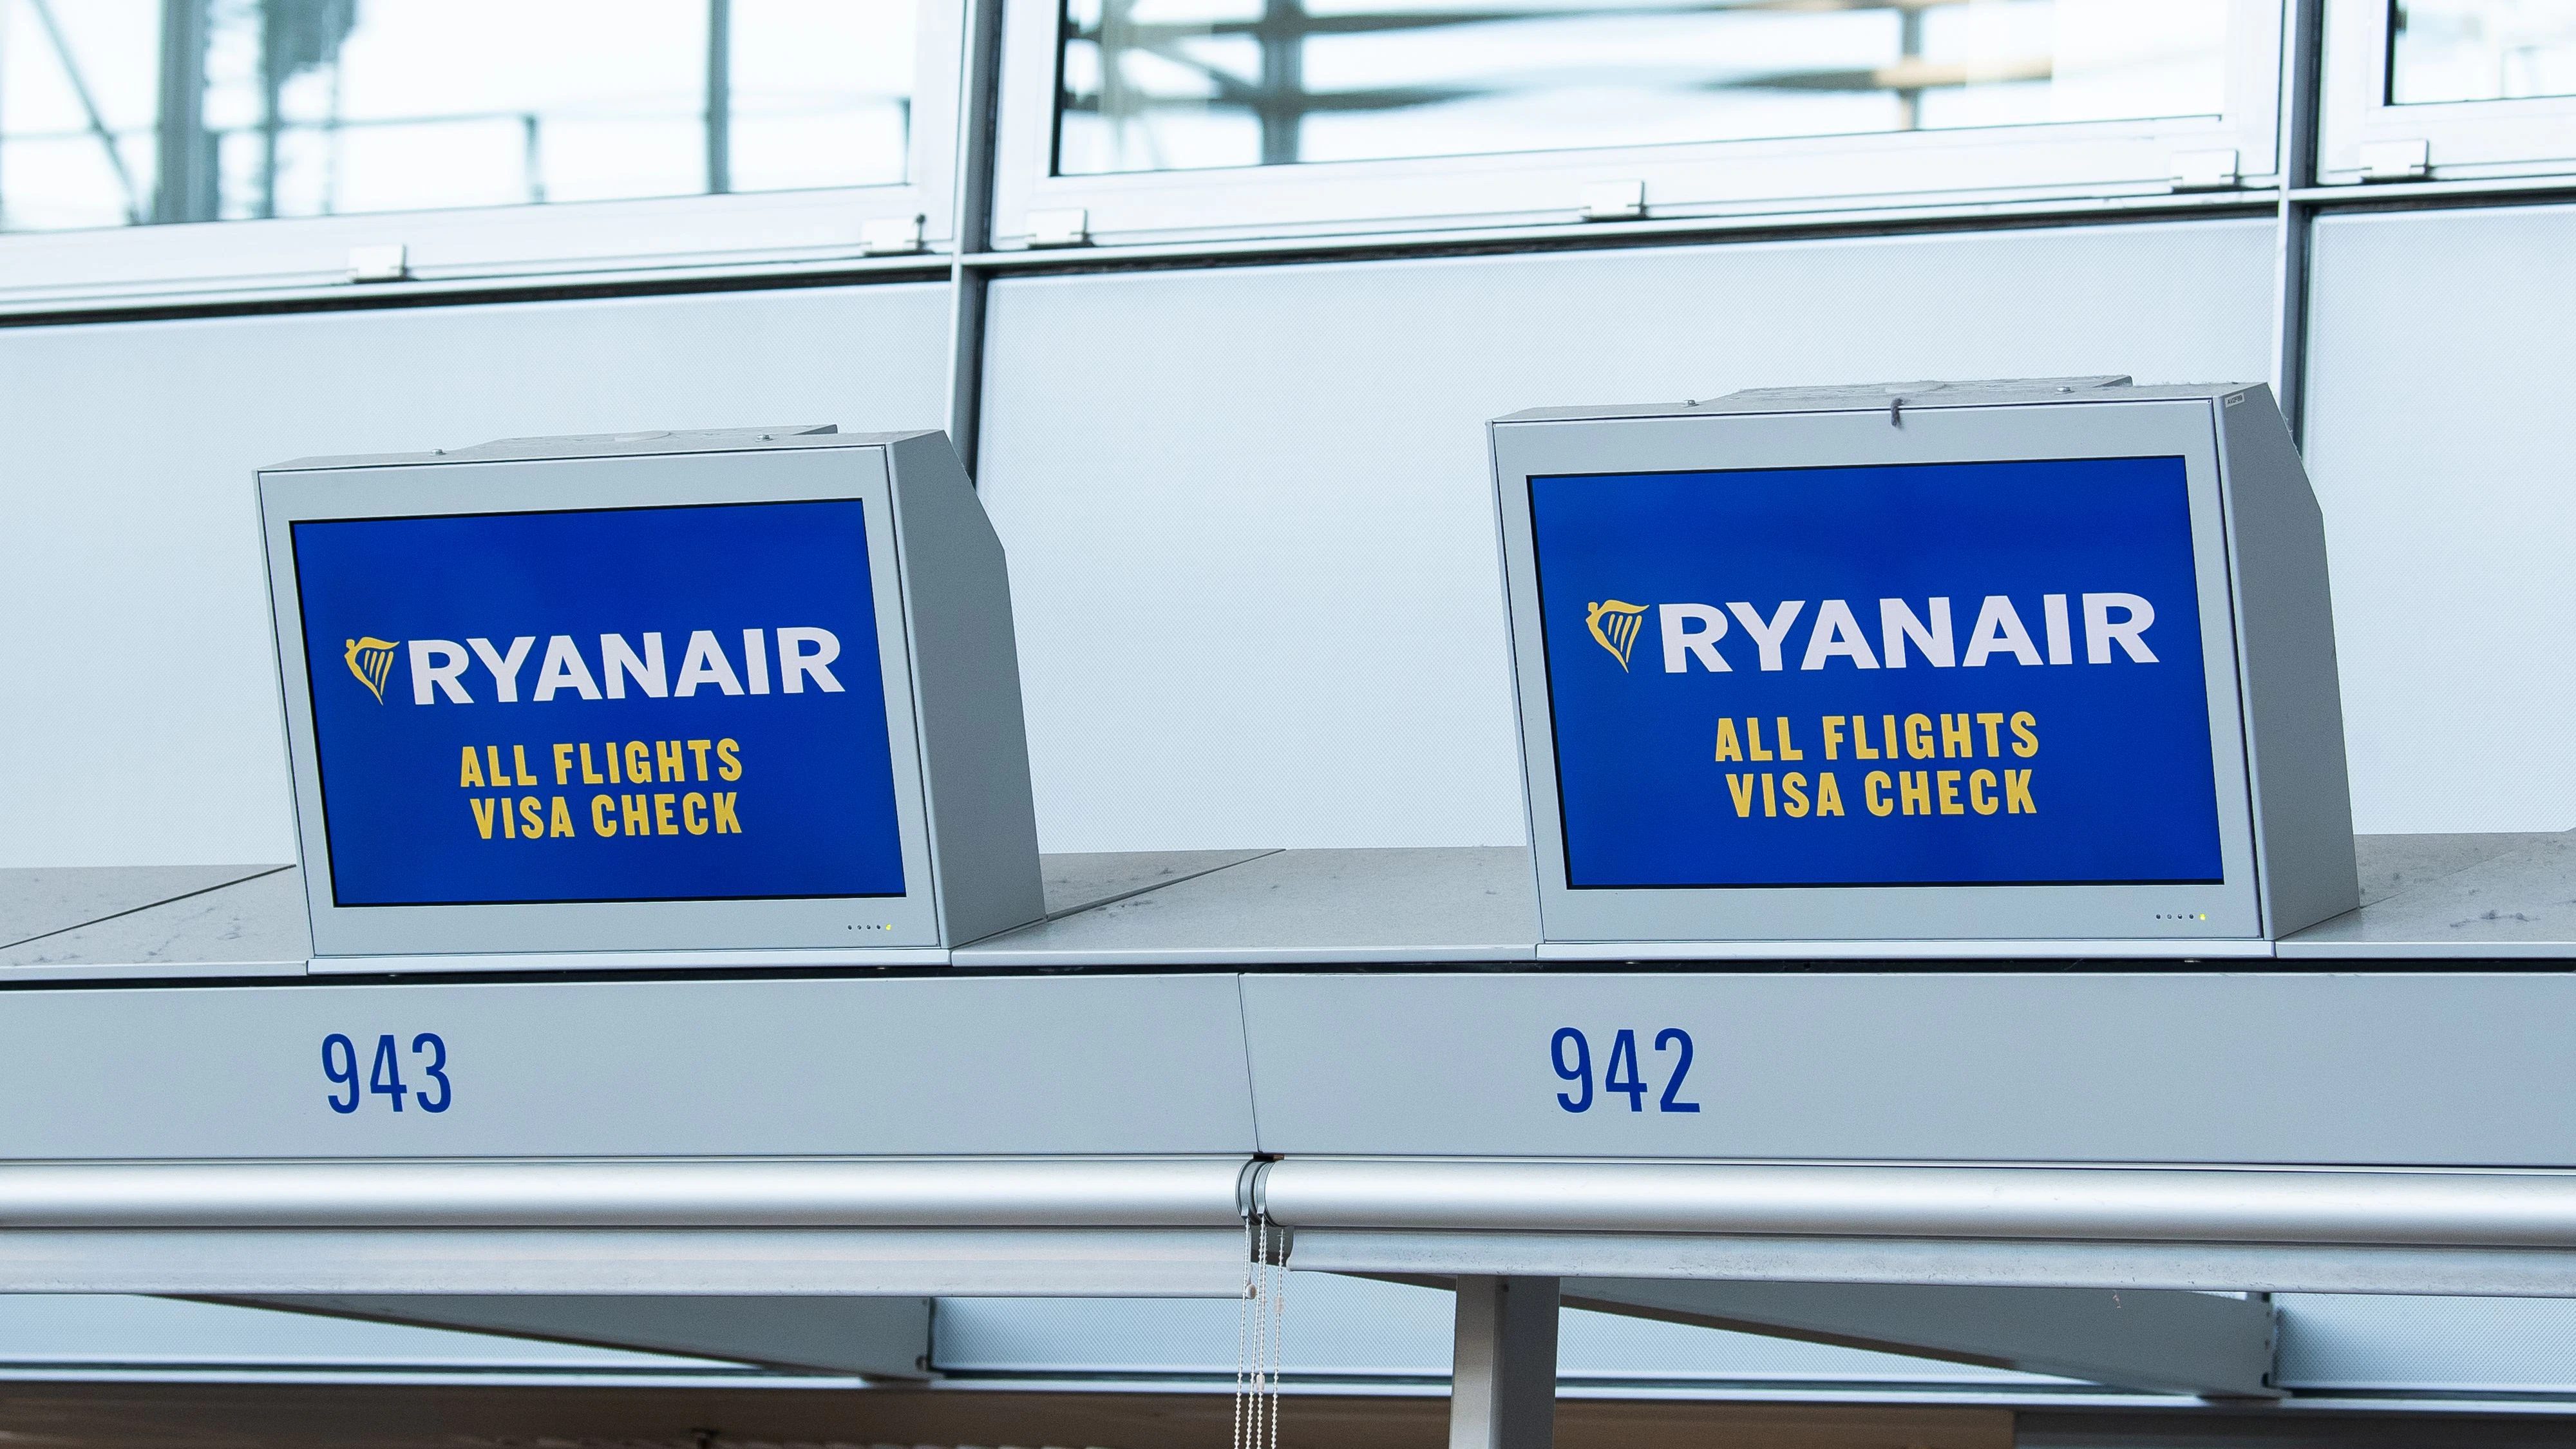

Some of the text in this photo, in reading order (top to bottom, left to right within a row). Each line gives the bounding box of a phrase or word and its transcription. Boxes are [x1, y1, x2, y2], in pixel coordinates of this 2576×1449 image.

[1659, 593, 2159, 672] RYANAIR
[408, 627, 845, 705] RYANAIR
[461, 739, 742, 787] ALL FLIGHTS
[1716, 712, 2038, 761] ALL FLIGHTS
[470, 792, 742, 839] VISA CHECK
[1725, 769, 2036, 817] VISA CHECK
[322, 1033, 451, 1113] 943
[1551, 1027, 1700, 1113] 942
